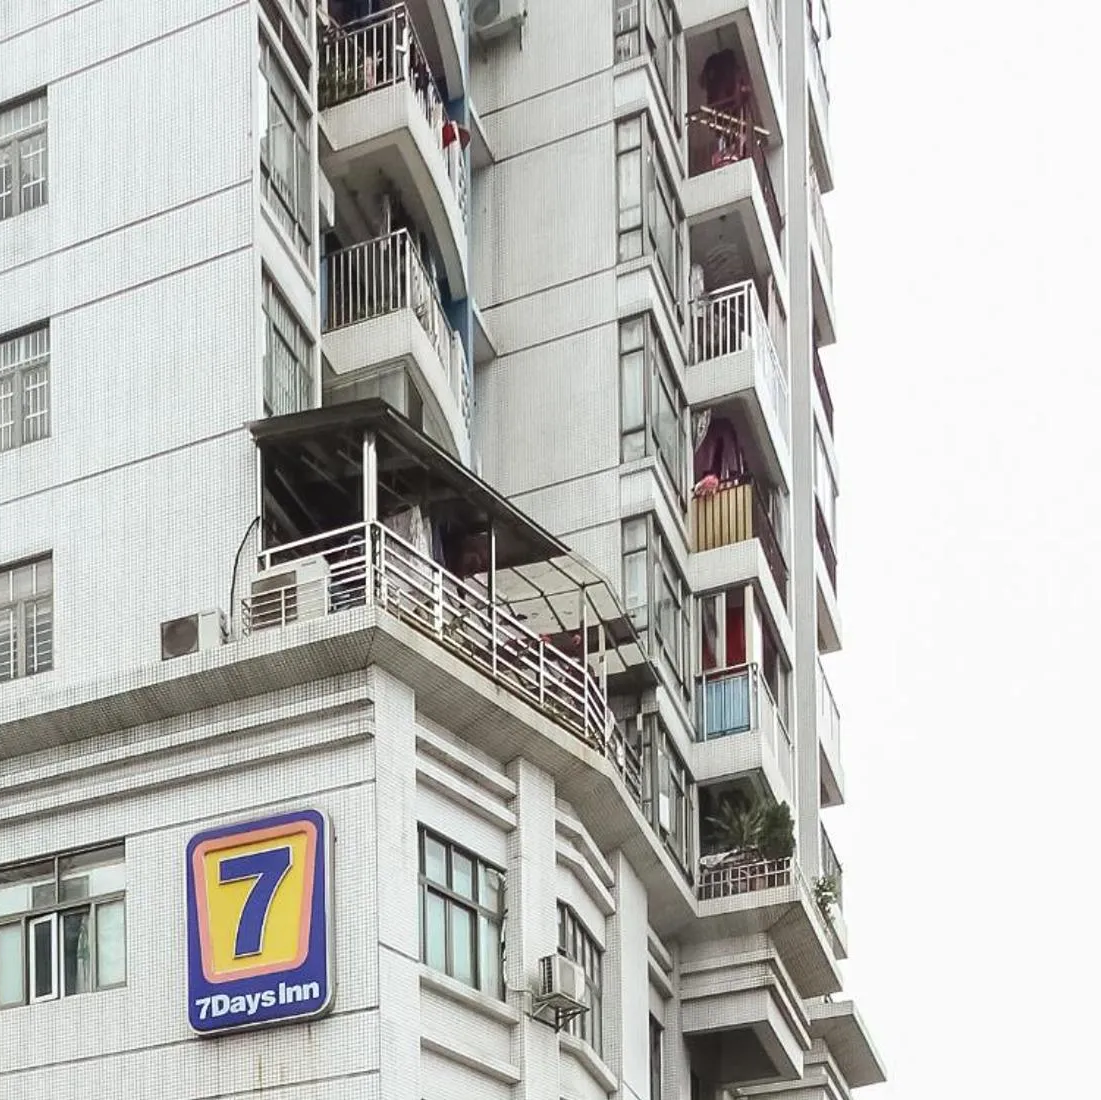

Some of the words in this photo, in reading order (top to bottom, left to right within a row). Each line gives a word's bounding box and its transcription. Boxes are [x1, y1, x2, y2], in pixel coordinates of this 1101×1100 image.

[218, 845, 293, 960] 7
[195, 989, 277, 1020] 7Days
[278, 981, 320, 1005] Inn
